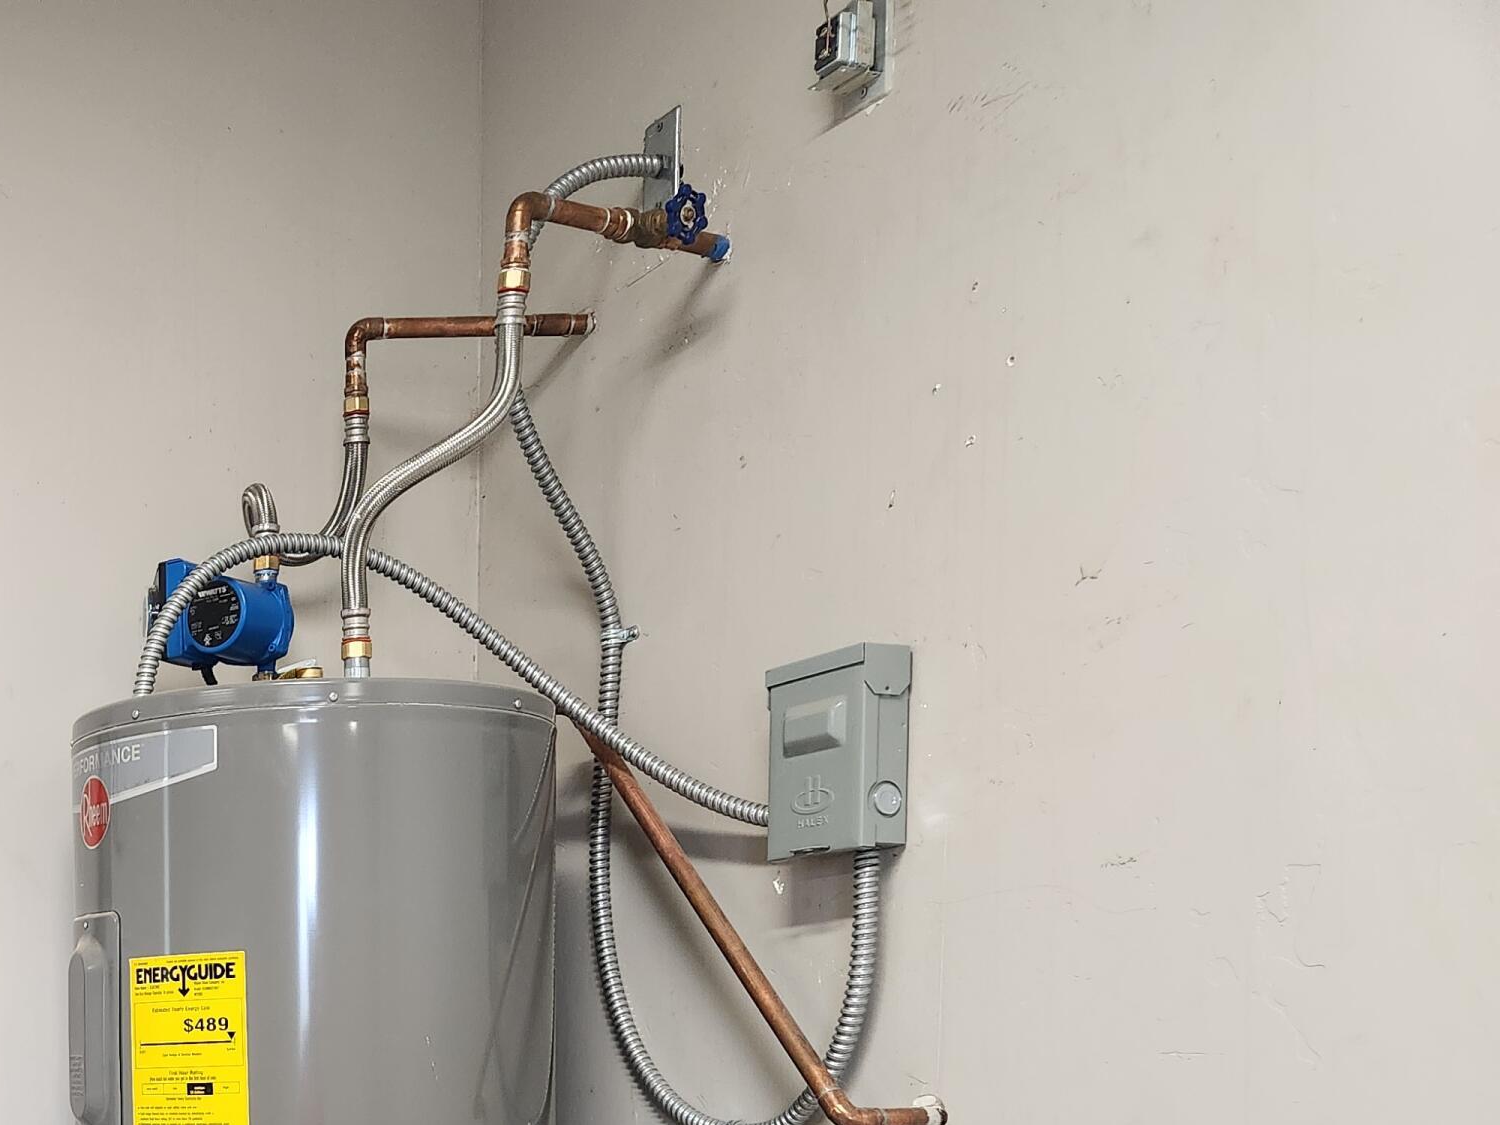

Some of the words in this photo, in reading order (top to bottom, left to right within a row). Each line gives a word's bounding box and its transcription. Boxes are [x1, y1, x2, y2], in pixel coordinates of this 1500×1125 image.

[83, 780, 109, 836] Rheem
[136, 962, 236, 986] ENERGYGUIDE
[183, 1017, 229, 1033] $489
